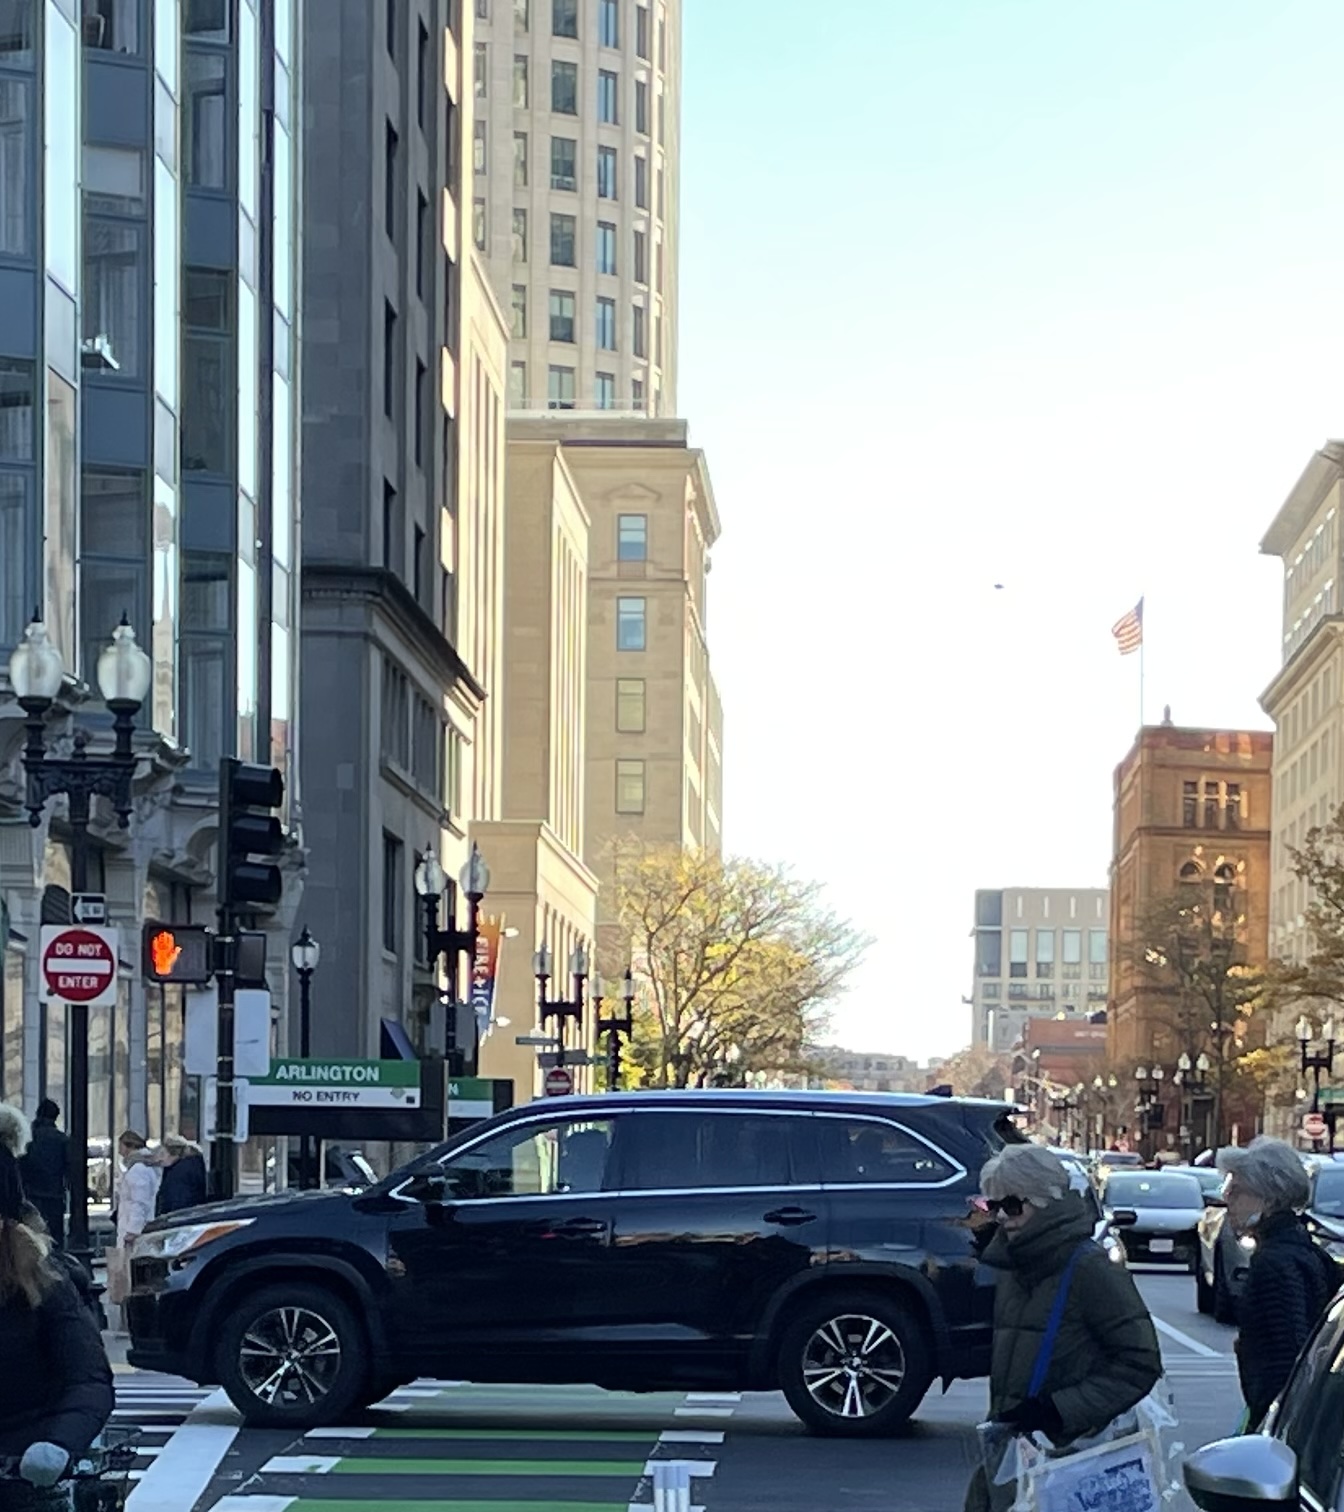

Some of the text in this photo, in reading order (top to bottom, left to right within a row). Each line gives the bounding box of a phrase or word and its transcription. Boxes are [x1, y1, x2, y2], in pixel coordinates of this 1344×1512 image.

[55, 942, 103, 957] DO NOT
[58, 975, 99, 989] ENTER
[275, 1064, 380, 1082] ARLINGTON
[292, 1090, 360, 1103] NO ENTRY
